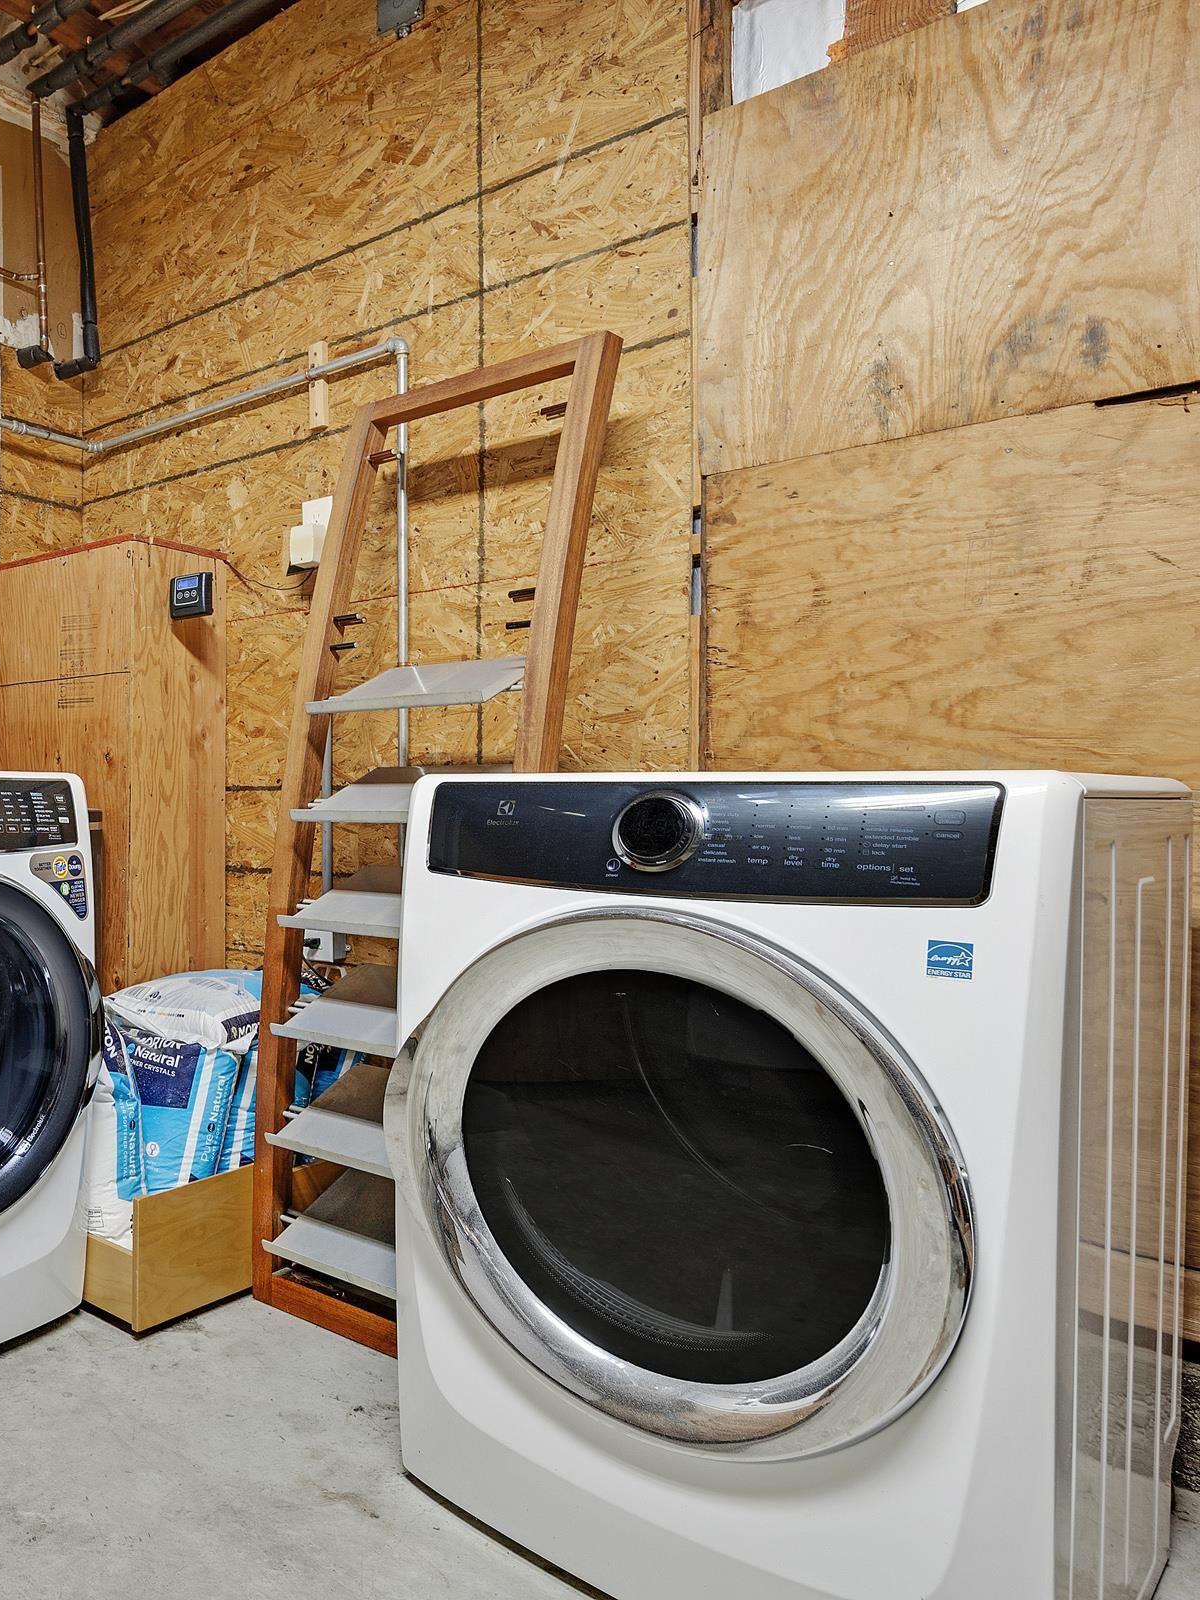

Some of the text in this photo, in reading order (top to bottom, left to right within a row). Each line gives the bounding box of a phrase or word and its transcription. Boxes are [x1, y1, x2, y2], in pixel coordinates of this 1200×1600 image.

[936, 832, 960, 840] cancel
[747, 857, 769, 865] temp
[784, 859, 803, 867] level
[821, 861, 840, 869] time
[856, 863, 892, 872] options
[899, 865, 914, 873] set
[953, 971, 972, 979] STAR
[134, 1045, 181, 1068] Natural
[143, 1063, 177, 1077] CRYSTALS
[200, 1075, 226, 1162] Pure Natural
[26, 1115, 46, 1141] Electrolux
[128, 1132, 138, 1181] Natural
